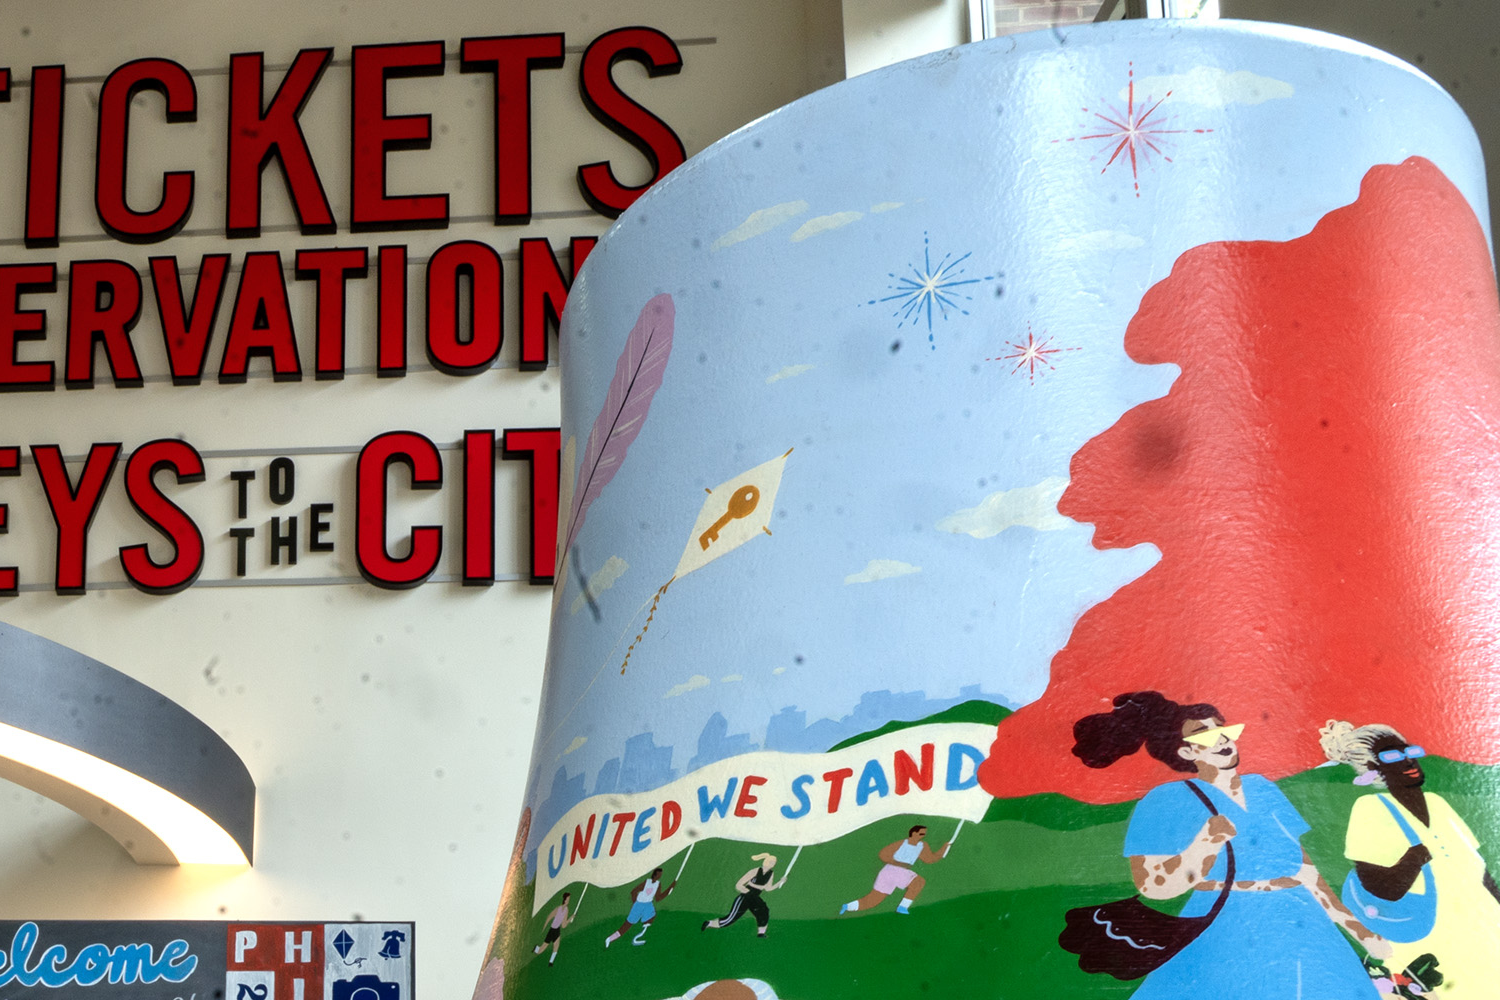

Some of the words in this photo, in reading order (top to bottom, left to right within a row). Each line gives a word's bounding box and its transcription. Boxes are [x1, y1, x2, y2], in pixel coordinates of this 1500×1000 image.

[230, 503, 334, 578] THE
[231, 458, 296, 520] TO
[355, 428, 562, 590] CIT
[547, 800, 682, 878] UNITED
[697, 774, 768, 823] WE
[780, 742, 985, 820] STAND
